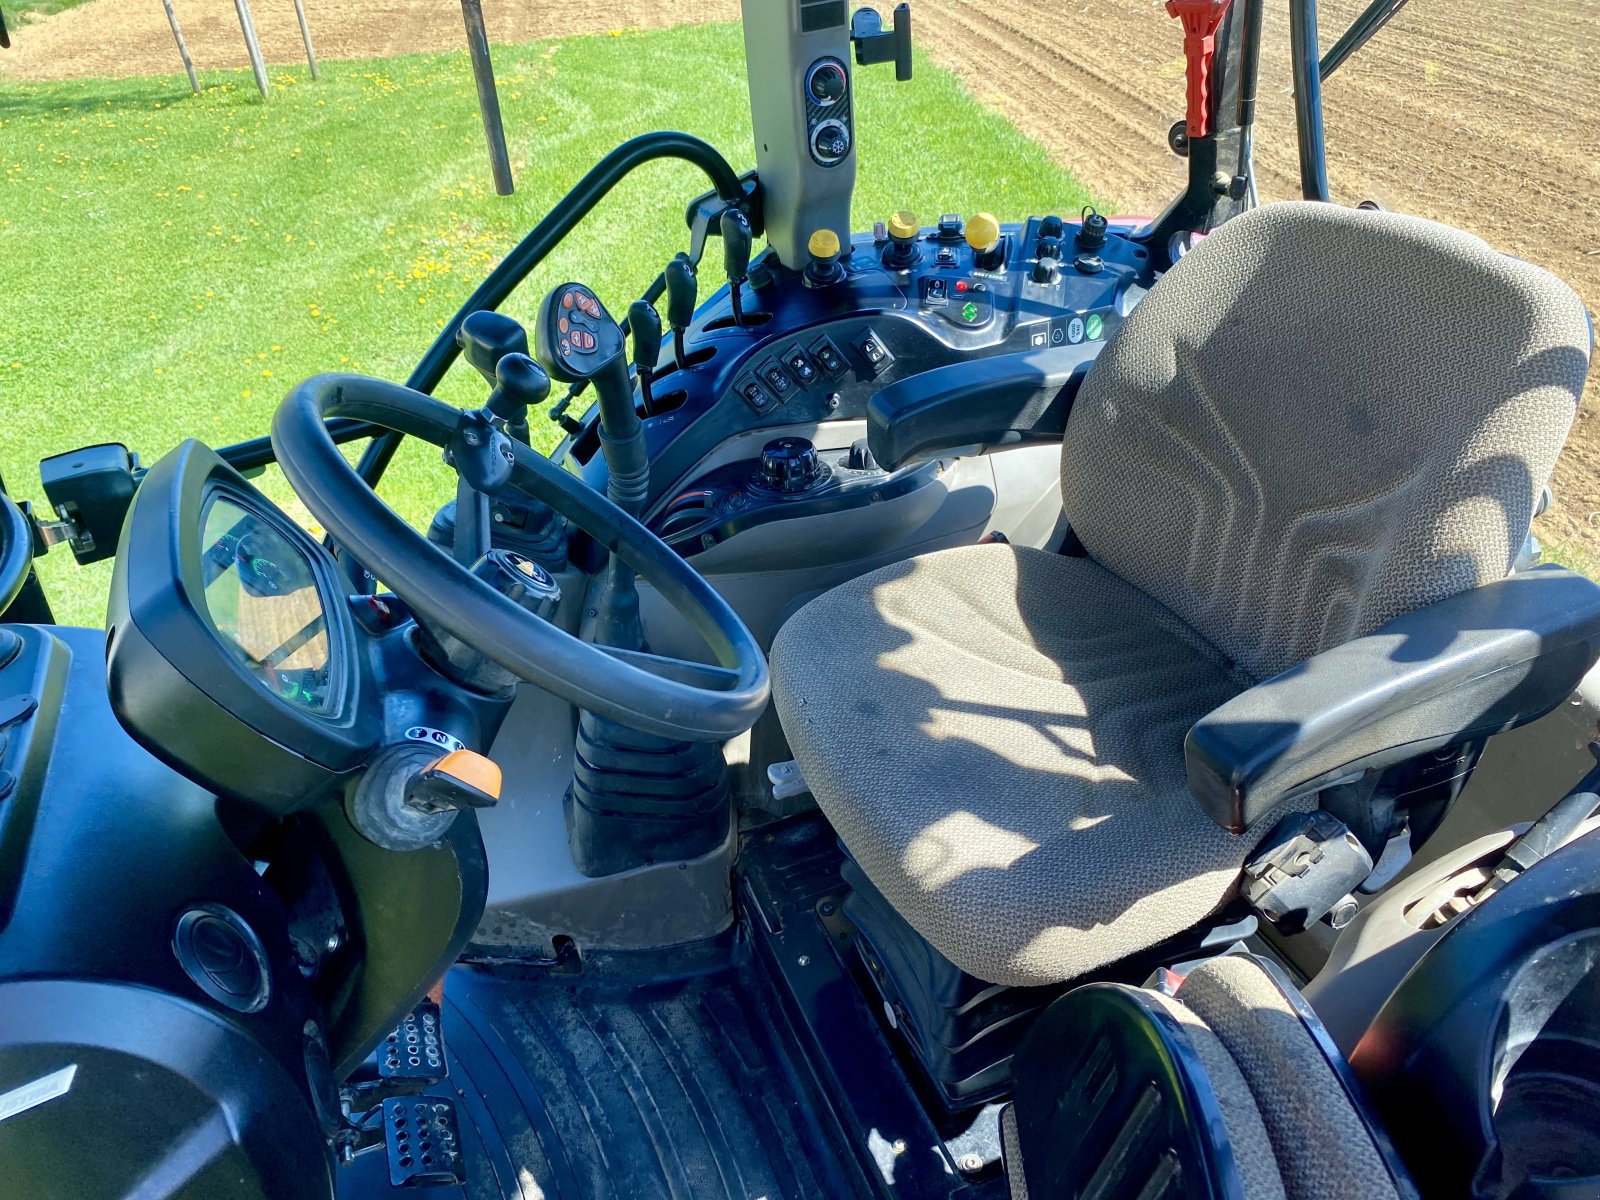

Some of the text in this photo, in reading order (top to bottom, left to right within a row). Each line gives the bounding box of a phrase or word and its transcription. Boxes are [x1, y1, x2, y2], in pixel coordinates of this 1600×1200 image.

[737, 213, 748, 226] 3
[683, 264, 693, 277] 2
[646, 303, 657, 316] 1
[436, 733, 446, 743] N
